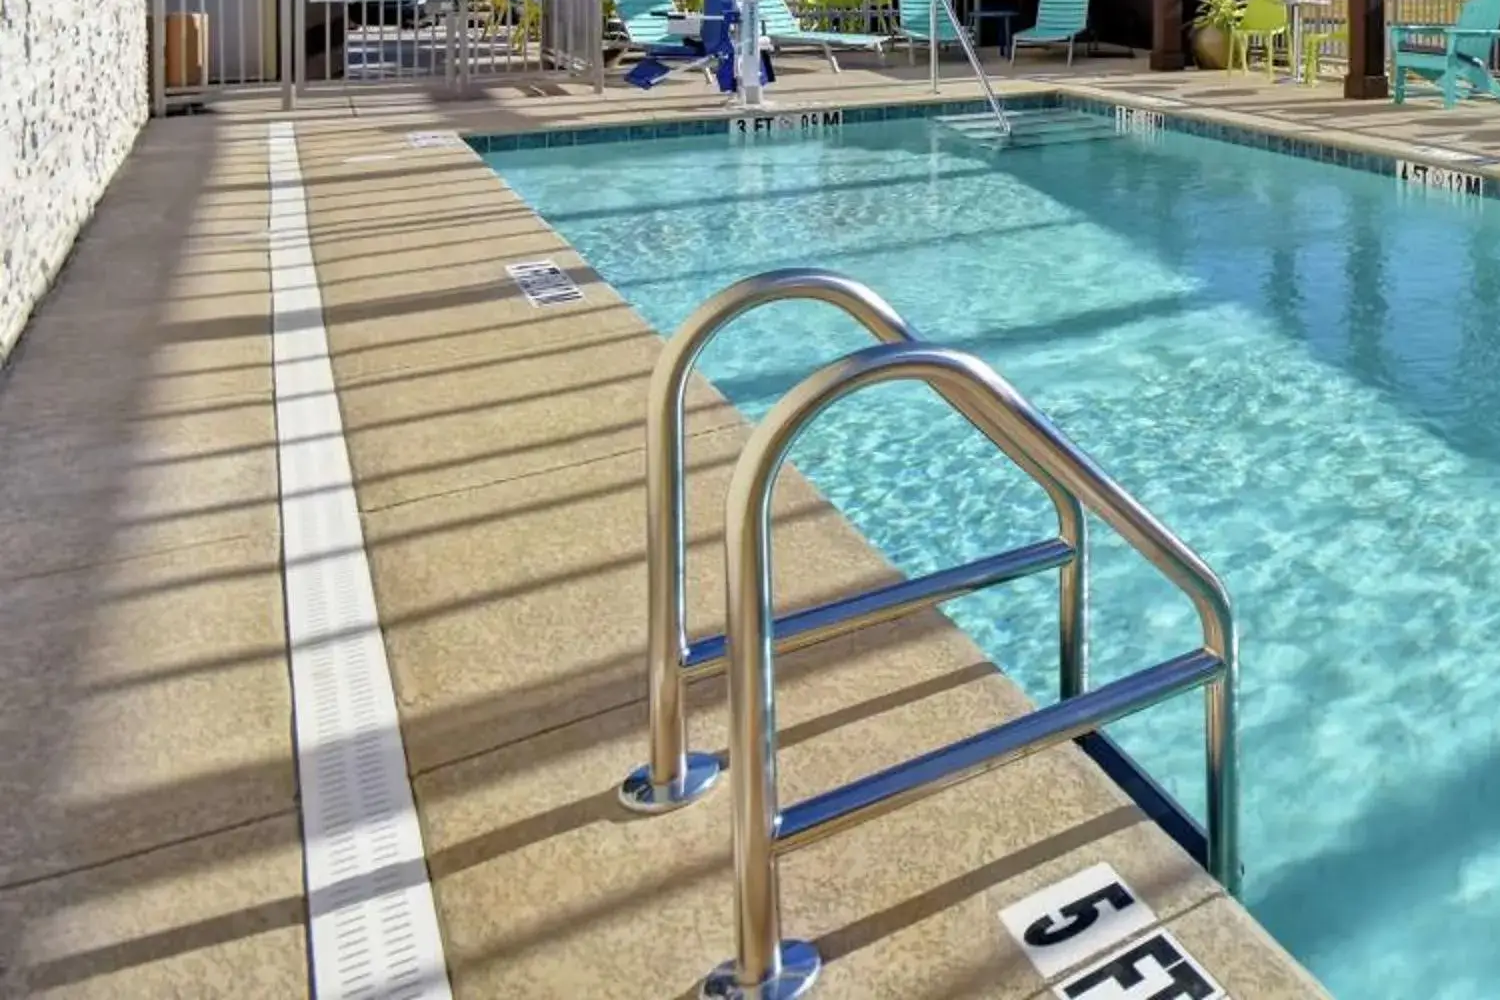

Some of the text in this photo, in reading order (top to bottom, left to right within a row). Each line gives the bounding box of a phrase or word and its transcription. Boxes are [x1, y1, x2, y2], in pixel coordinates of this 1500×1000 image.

[754, 117, 775, 133] FT
[823, 111, 841, 127] M
[1465, 175, 1481, 197] M
[1023, 881, 1216, 1000] 5 FT
